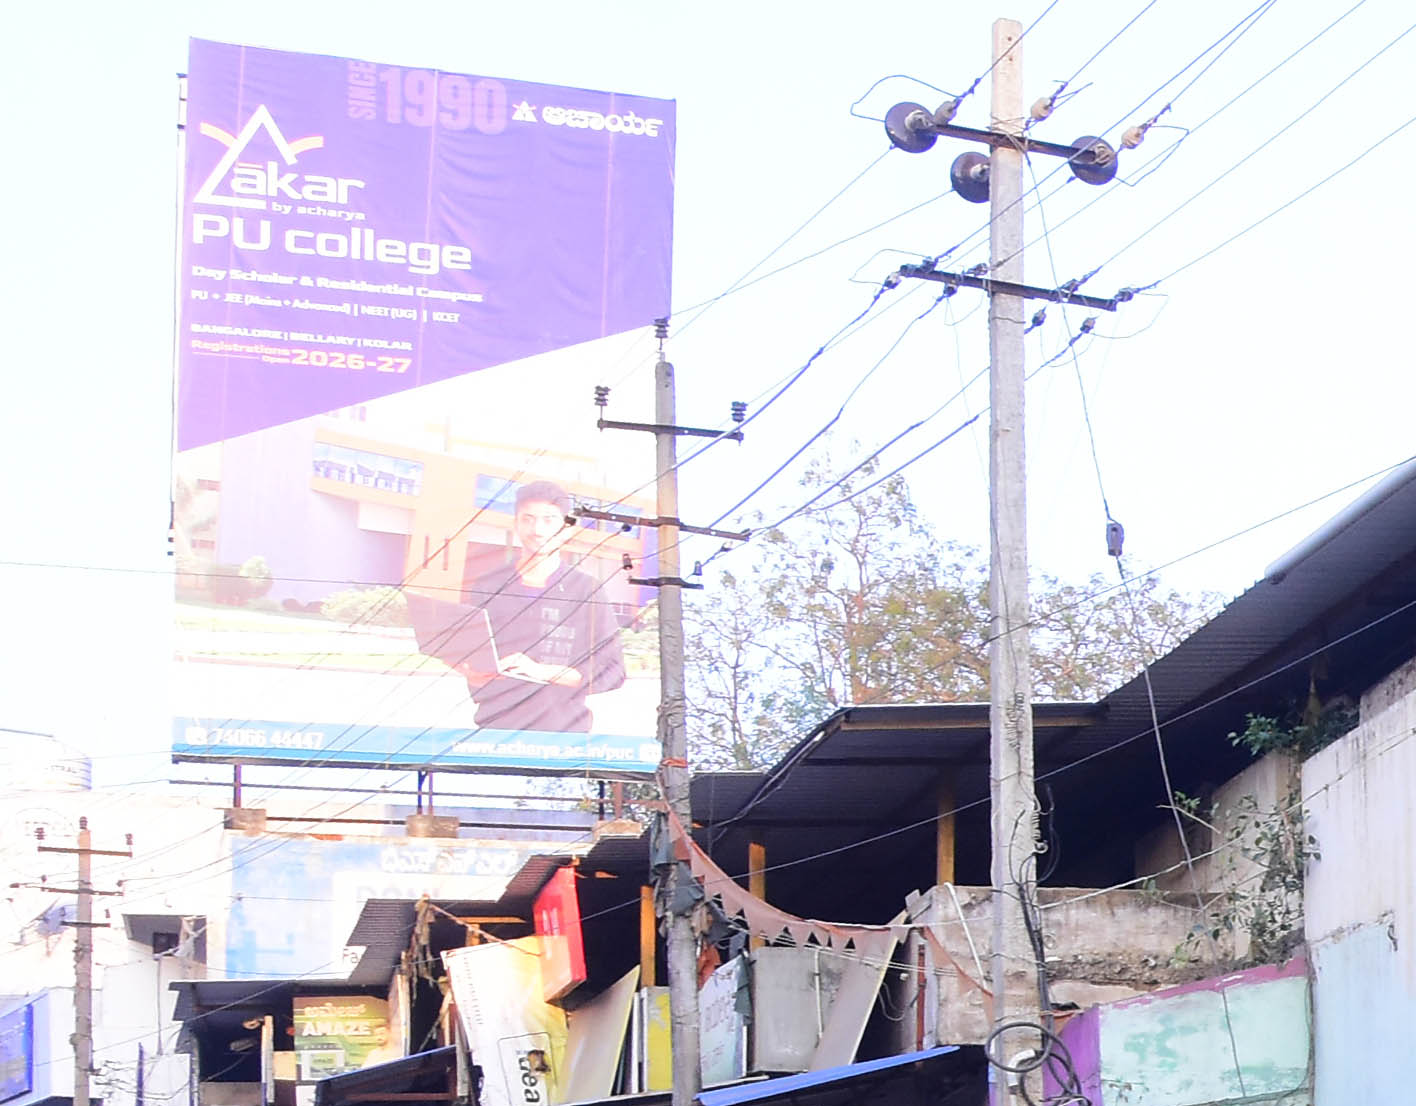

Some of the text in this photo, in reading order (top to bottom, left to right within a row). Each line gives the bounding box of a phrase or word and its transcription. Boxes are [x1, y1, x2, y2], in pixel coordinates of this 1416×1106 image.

[348, 60, 376, 120] SINCE
[380, 67, 508, 135] 1990
[271, 202, 366, 222] by acharya
[192, 212, 473, 276] PU college
[191, 265, 228, 281] Day
[229, 268, 298, 285] Scholar
[316, 276, 415, 297] Residential
[415, 286, 484, 303] Campus
[191, 289, 209, 300] PU
[191, 323, 413, 351] BANGALORE BELLARY KOLAR
[191, 339, 413, 374] Registrations 2026-27
[302, 1021, 373, 1037] AMAZE
